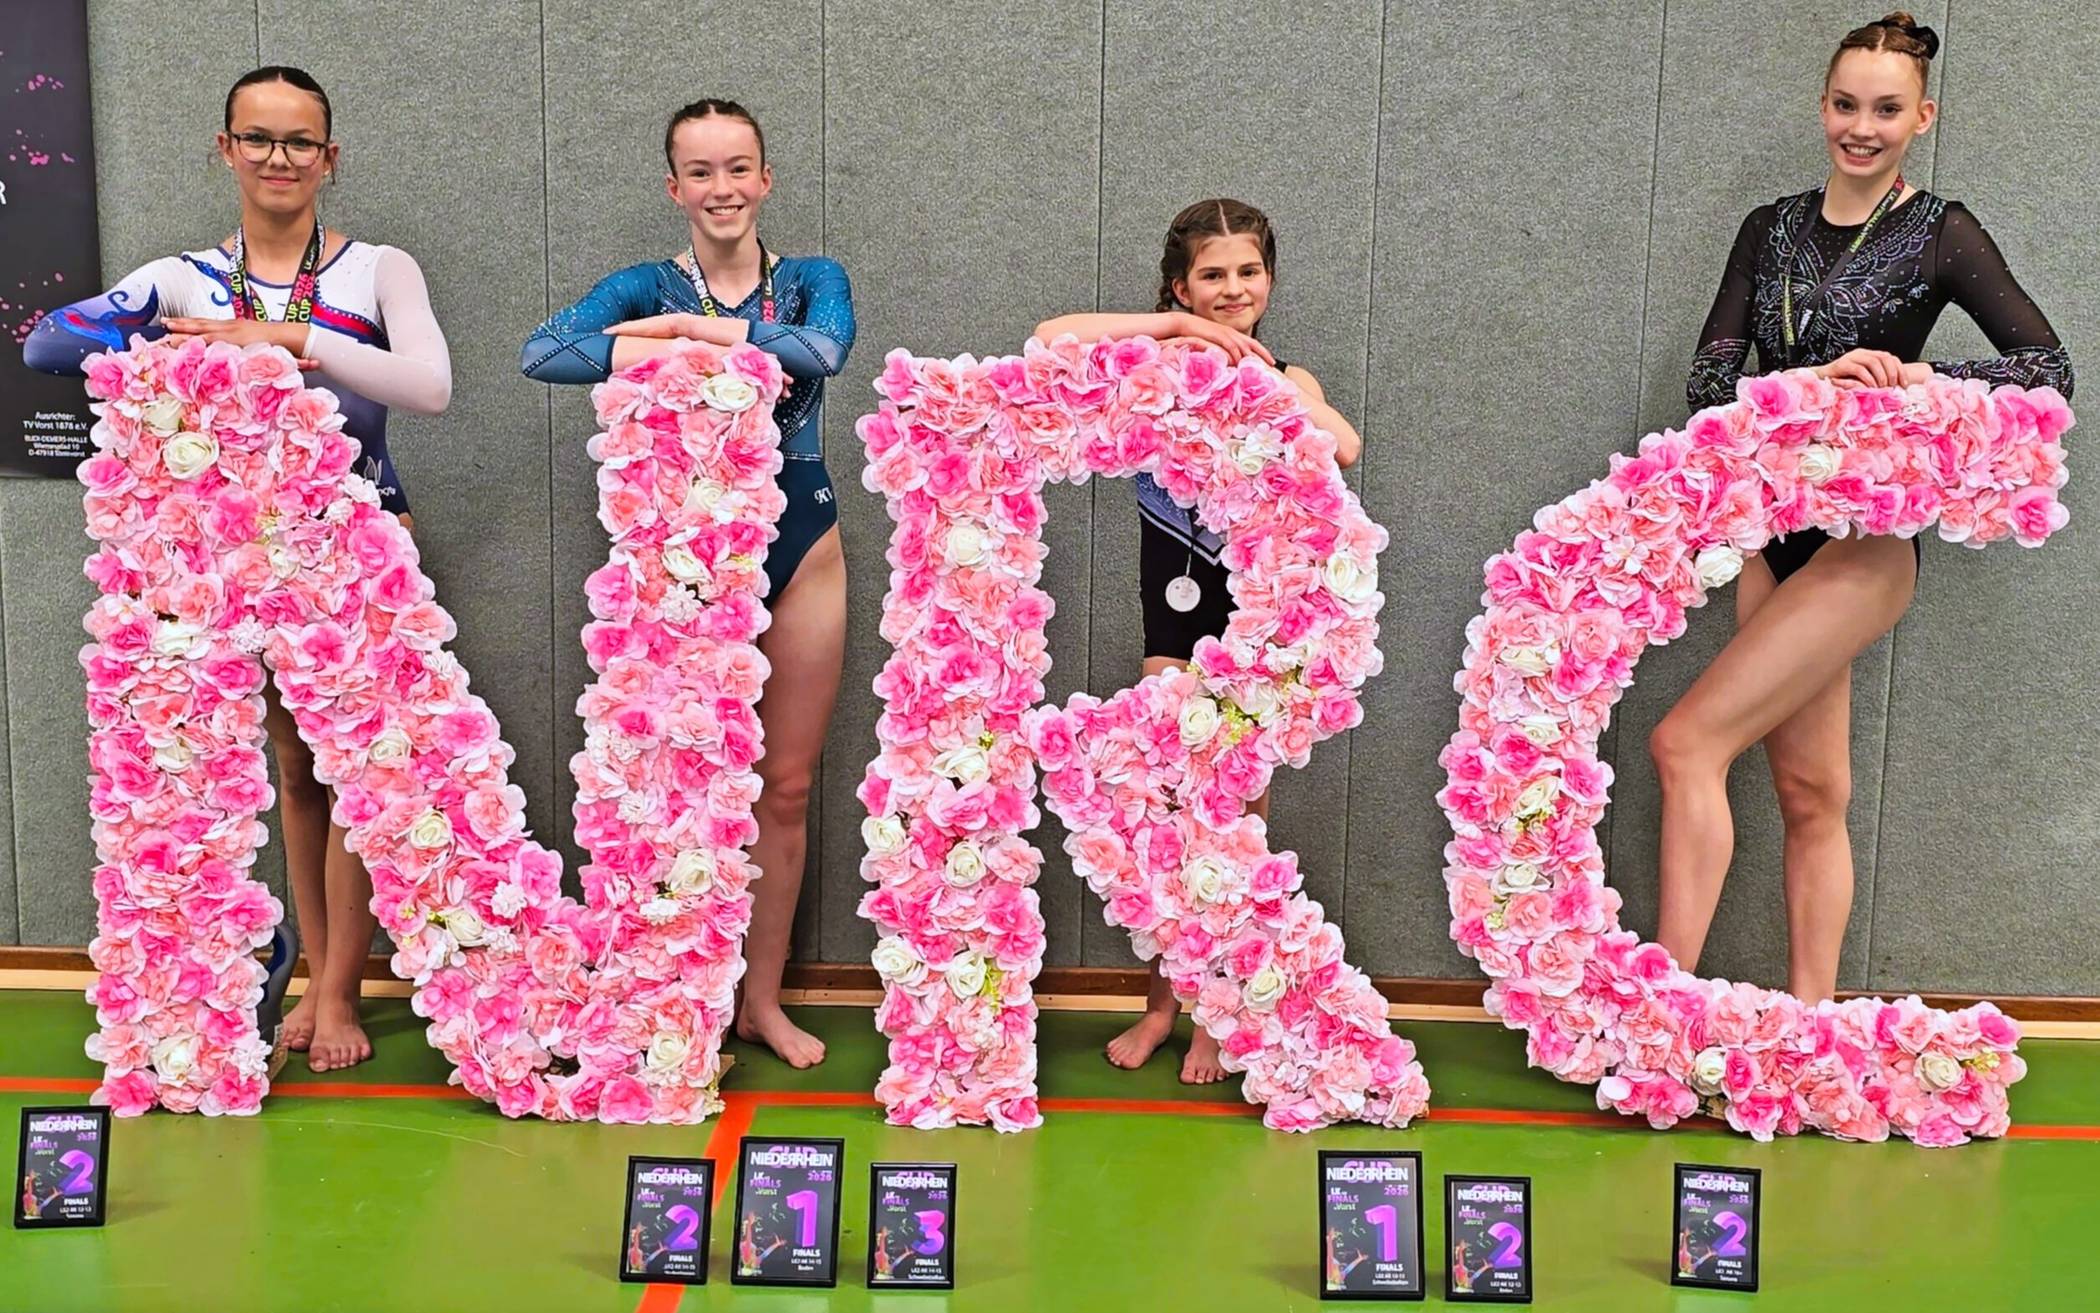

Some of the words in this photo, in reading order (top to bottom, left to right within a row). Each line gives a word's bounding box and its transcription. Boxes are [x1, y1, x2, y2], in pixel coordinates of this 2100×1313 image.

[230, 272, 243, 294] CUP
[299, 298, 312, 322] CUP
[763, 300, 775, 323] 026
[23, 420, 33, 429] TV
[34, 421, 54, 430] Vorst
[751, 1151, 833, 1167] NIEDERRHEIN
[59, 1149, 95, 1196] 2
[807, 1172, 832, 1182] 2026
[1326, 1167, 1409, 1181] NIEDERRHEIN
[750, 1179, 782, 1188] FINALS
[1384, 1186, 1409, 1196] 2026
[64, 1198, 89, 1206] FINALS
[1327, 1194, 1360, 1203] FINALS
[786, 1190, 818, 1247] 1
[664, 1204, 700, 1251] 2
[911, 1209, 945, 1255] 3
[1364, 1204, 1398, 1262] 1
[1712, 1211, 1747, 1257] 2
[1488, 1222, 1522, 1269] 2
[793, 1249, 821, 1257] FINALS
[915, 1258, 939, 1266] FINALS
[1376, 1263, 1403, 1272] FINALS
[1717, 1260, 1743, 1269] FINALS
[1494, 1272, 1519, 1280] FINALS
